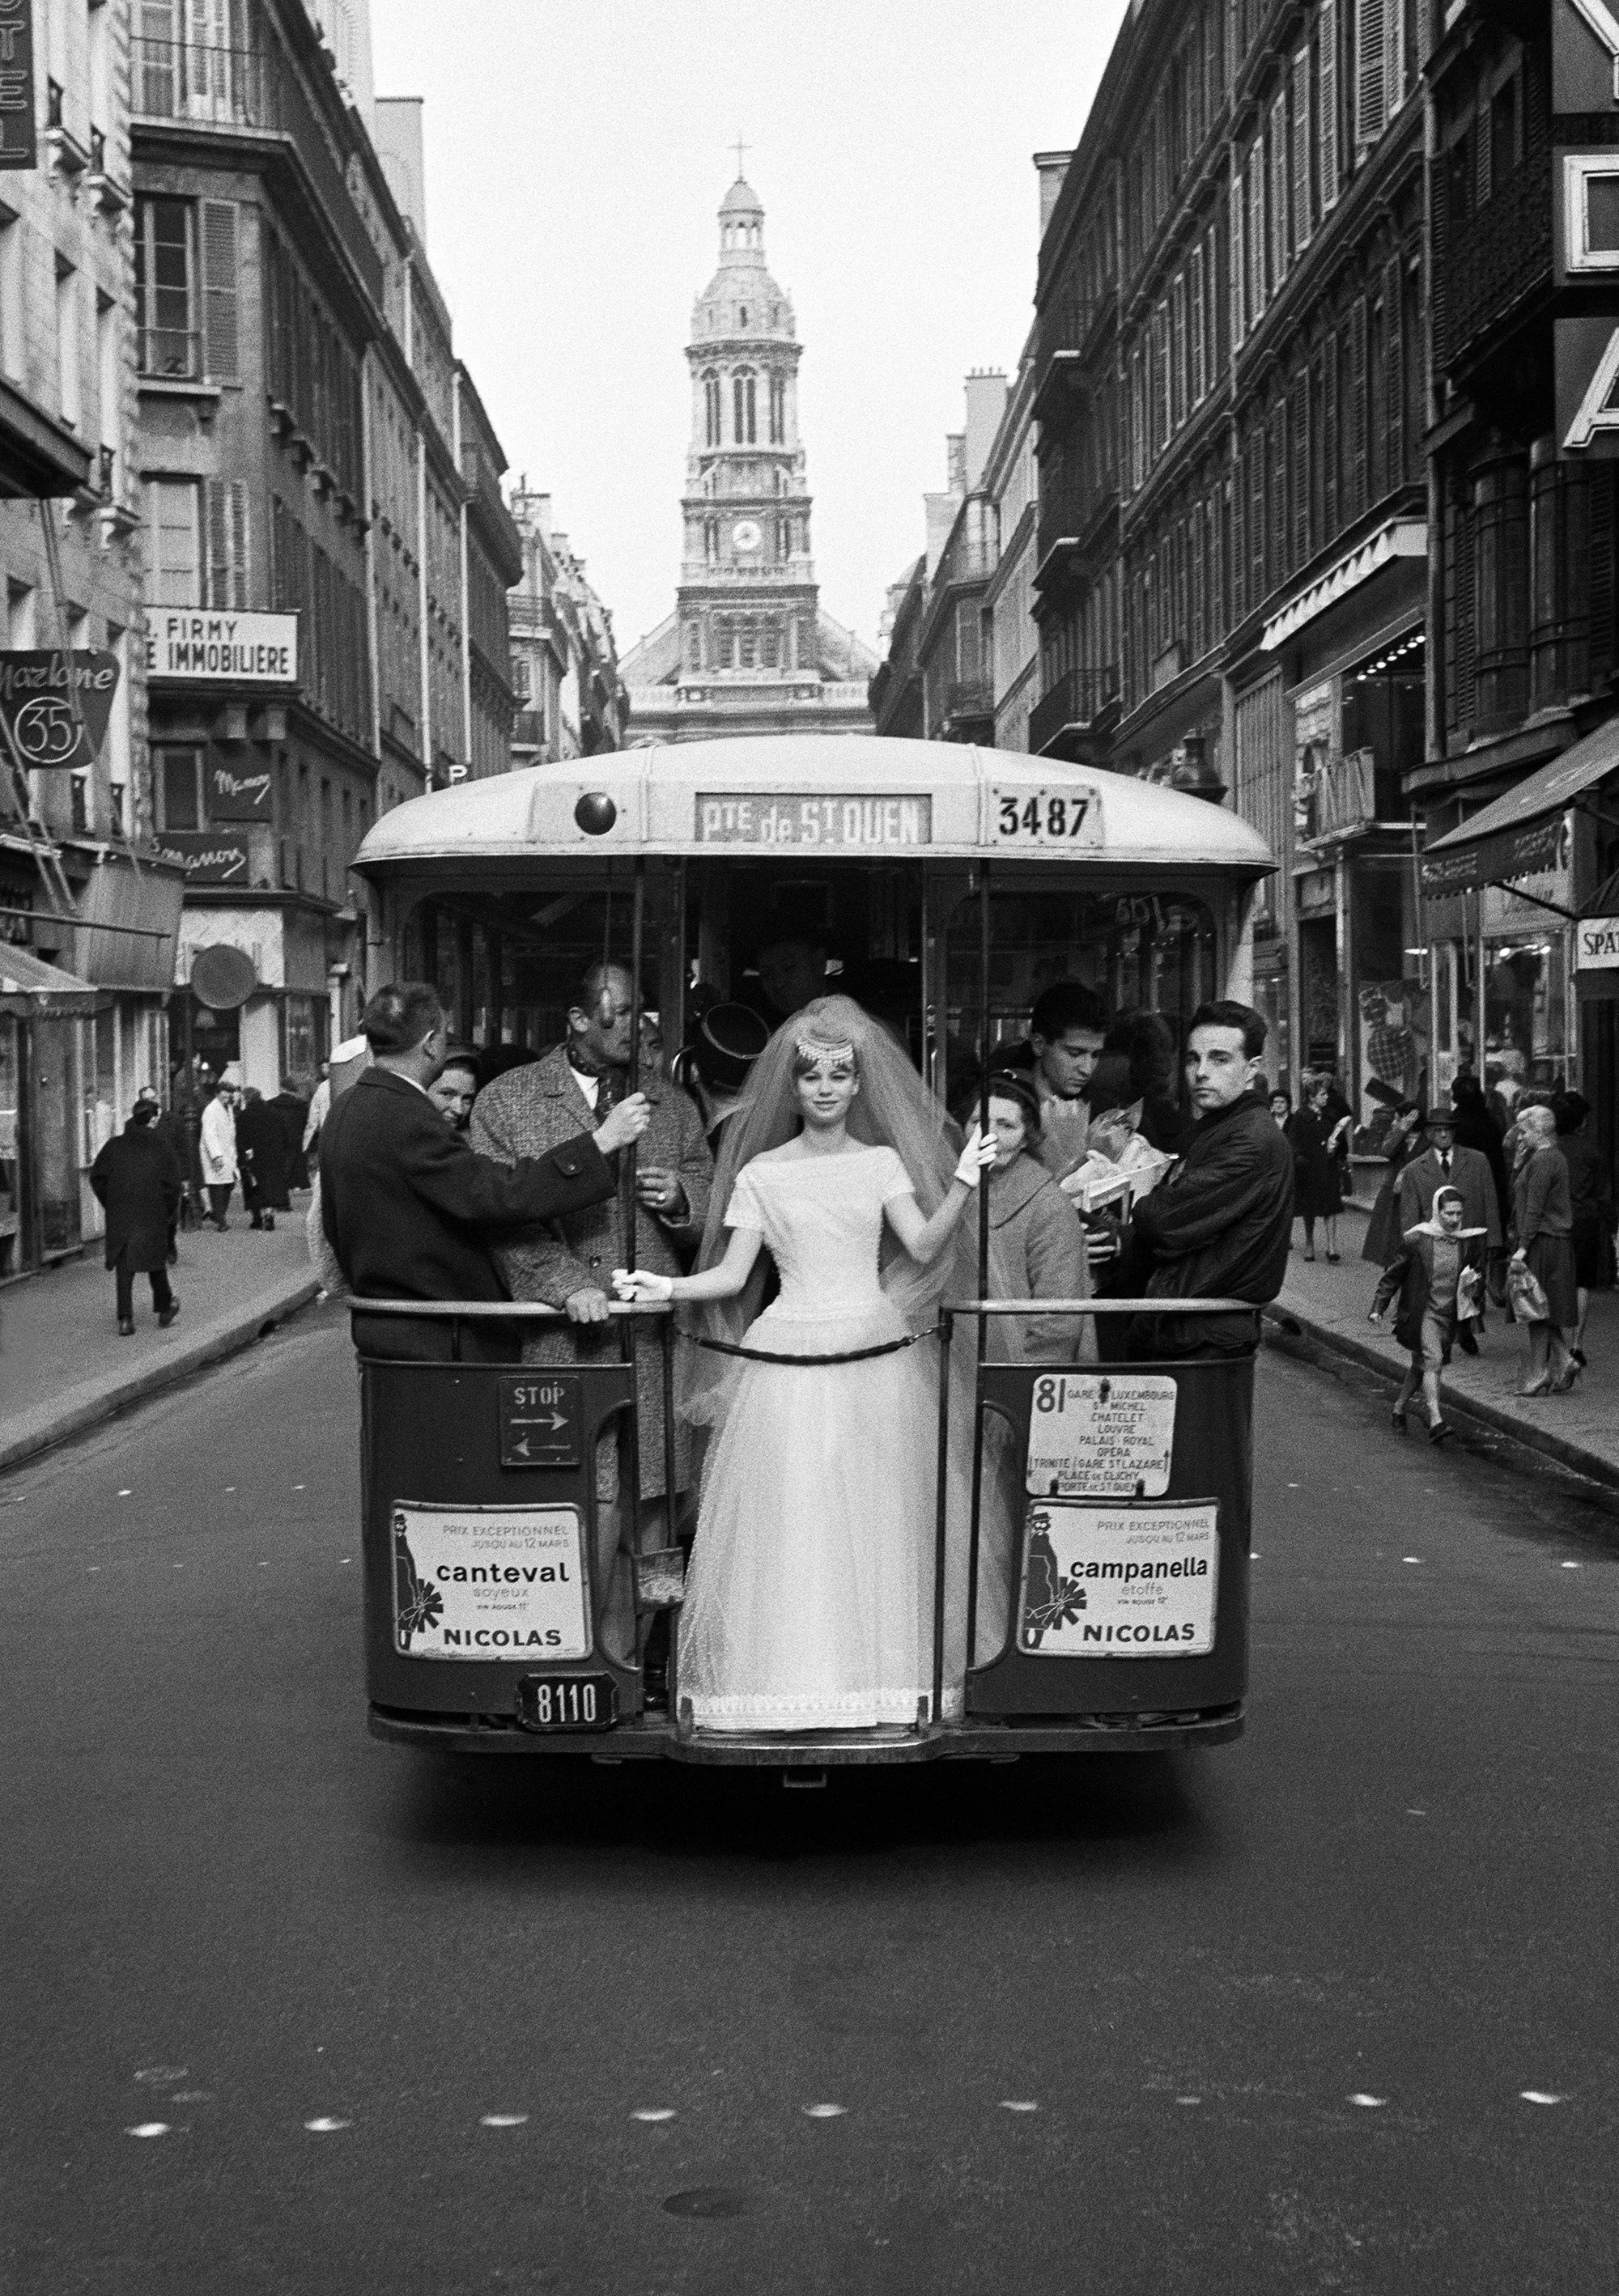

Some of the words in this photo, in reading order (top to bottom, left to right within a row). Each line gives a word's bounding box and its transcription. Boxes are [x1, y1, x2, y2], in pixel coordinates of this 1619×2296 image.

[168, 618, 237, 641] FIRMY
[26, 706, 71, 753] 35
[448, 765, 468, 783] P
[843, 800, 919, 844] OUEN
[999, 796, 1089, 837] 3487
[1583, 932, 1619, 956] SPA
[513, 1386, 565, 1405] STOP
[1036, 1378, 1066, 1413] 81
[1110, 1402, 1147, 1411] MICHEL
[1098, 1424, 1137, 1434] LOUVRE
[436, 1562, 571, 1582] canteval
[1070, 1556, 1208, 1583] campanella
[444, 1628, 562, 1647] NICOLAS
[1083, 1623, 1196, 1642] NICOLAS
[538, 1684, 597, 1723] 8110
